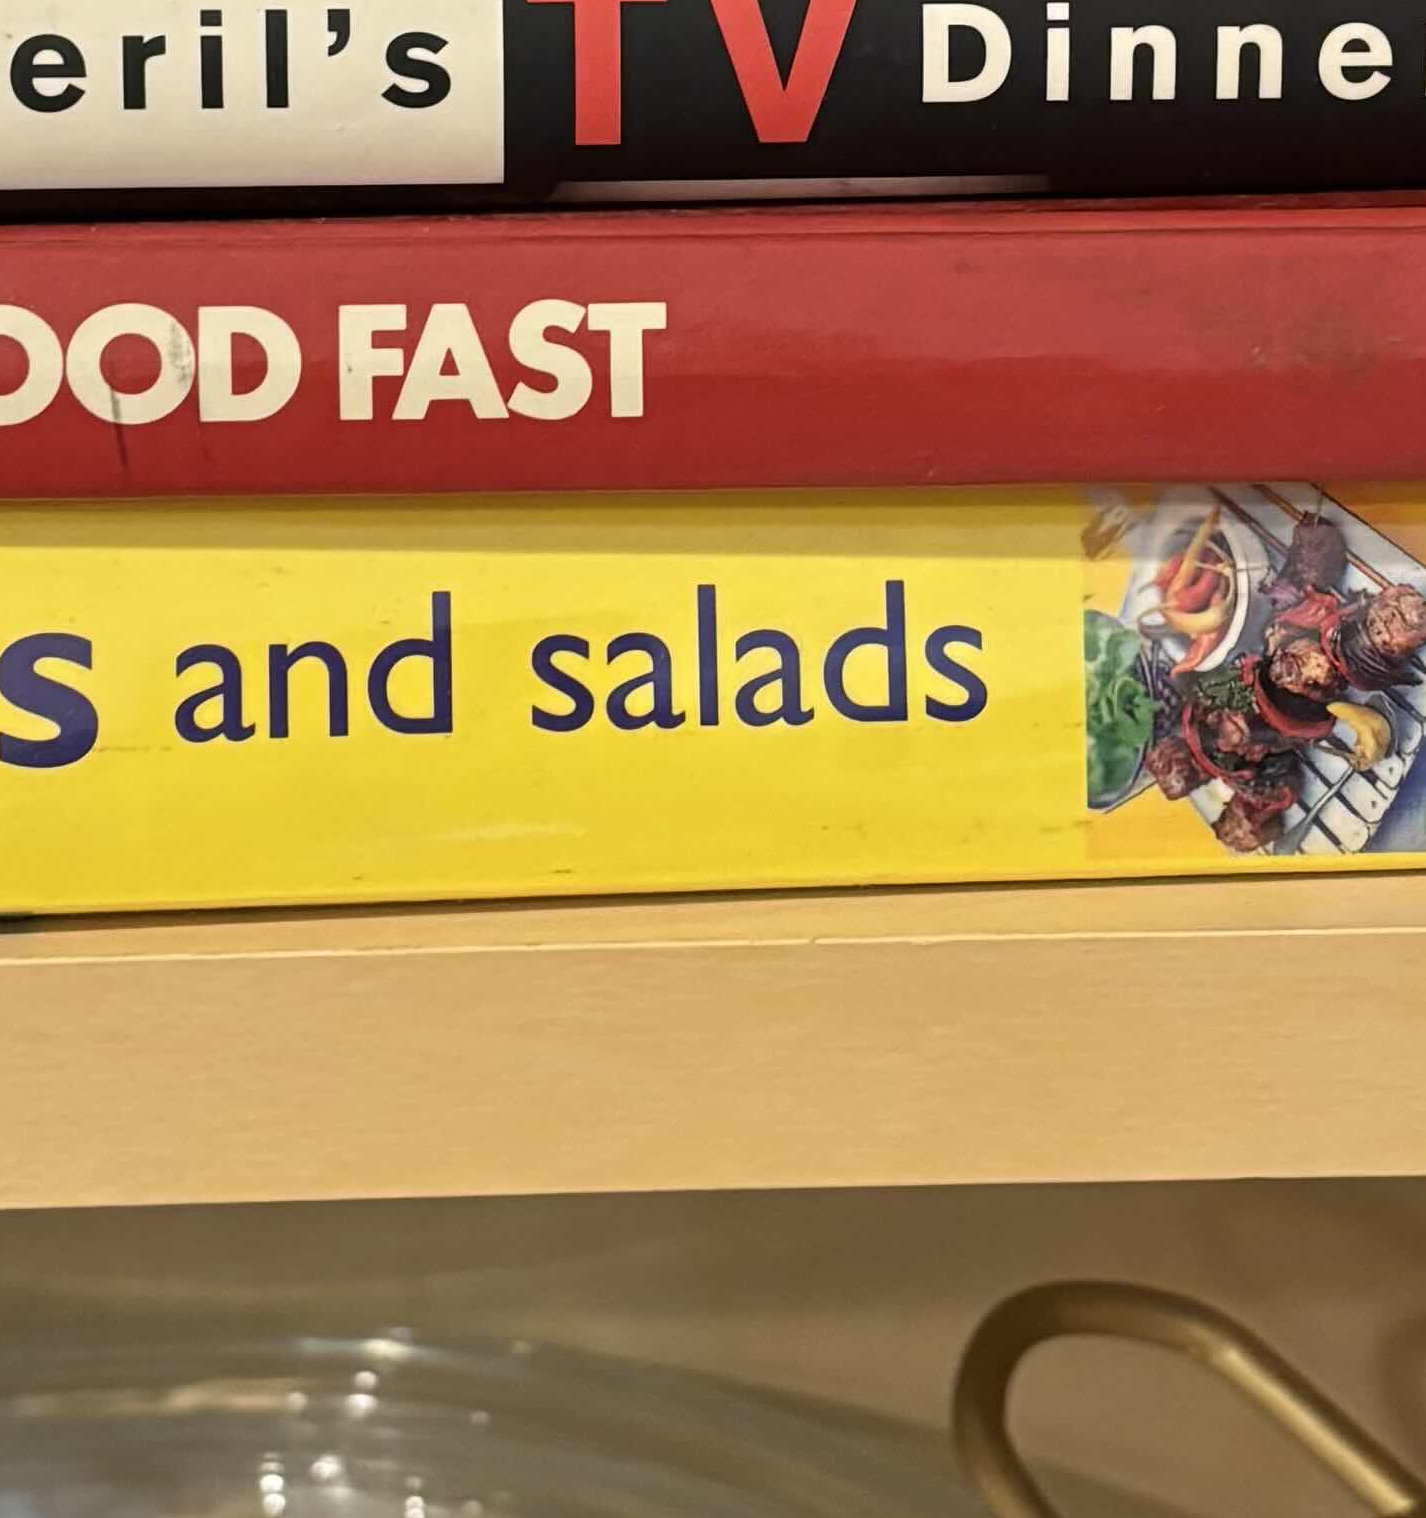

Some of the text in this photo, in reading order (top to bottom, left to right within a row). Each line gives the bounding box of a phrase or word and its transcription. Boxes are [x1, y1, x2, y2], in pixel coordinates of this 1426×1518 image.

[337, 298, 668, 421] FAST
[173, 590, 454, 744] and
[530, 579, 989, 733] salads
